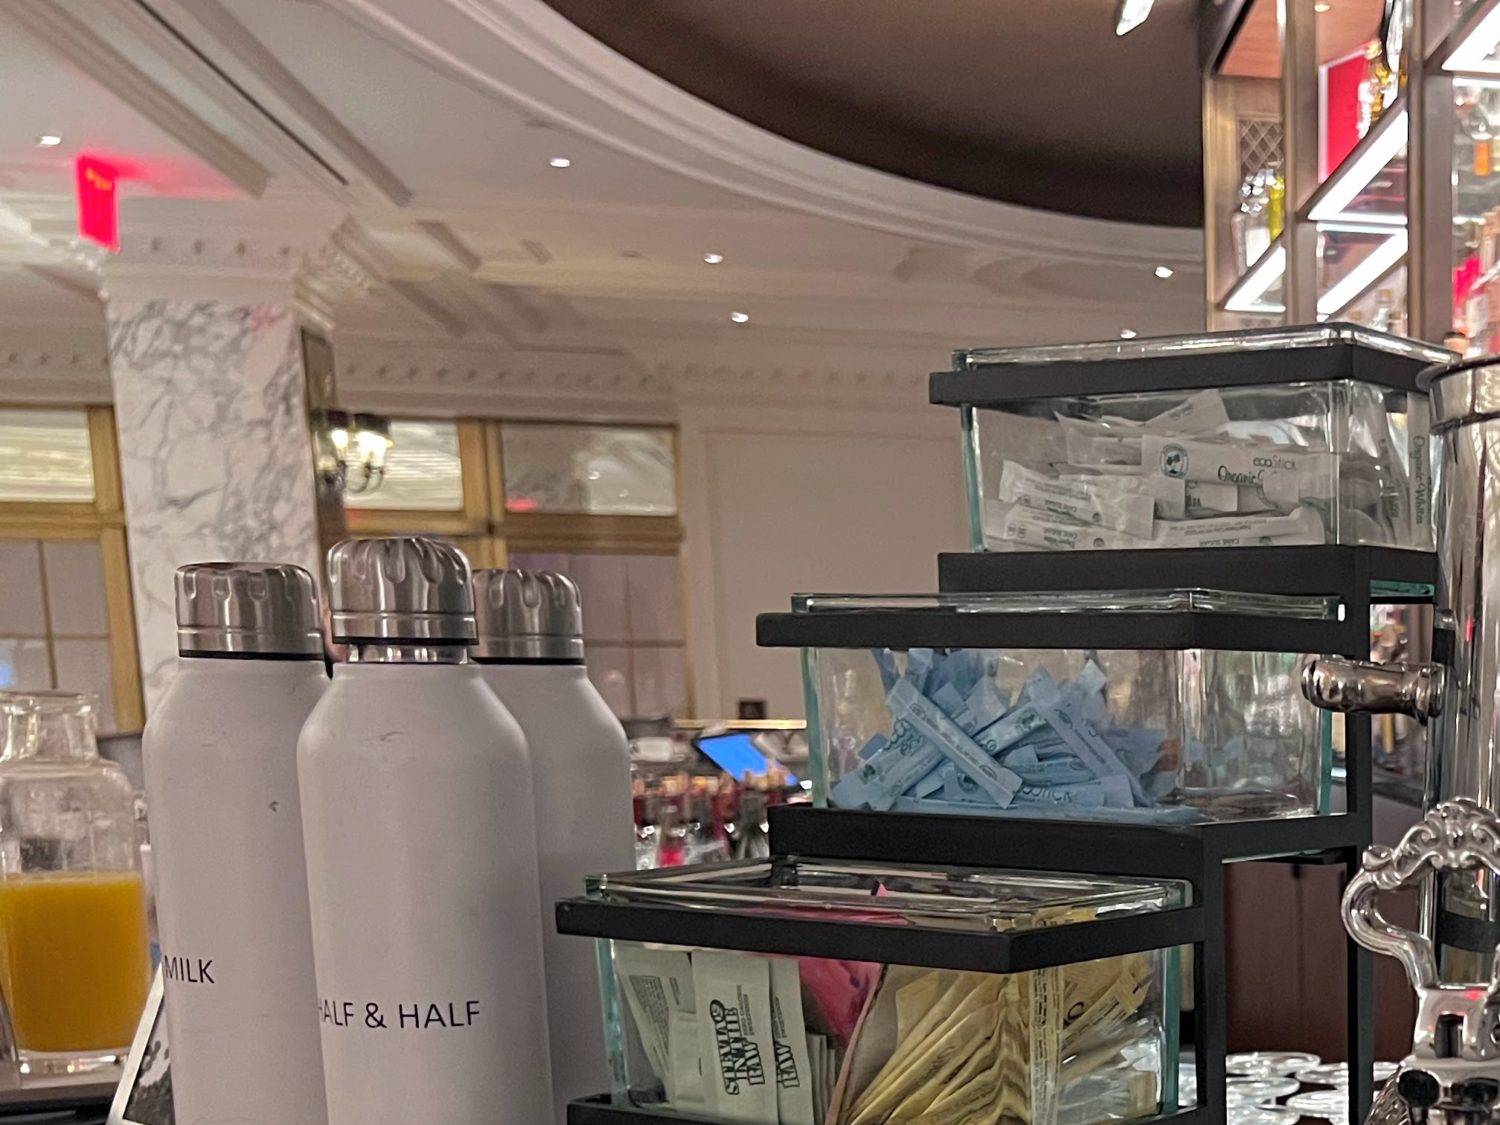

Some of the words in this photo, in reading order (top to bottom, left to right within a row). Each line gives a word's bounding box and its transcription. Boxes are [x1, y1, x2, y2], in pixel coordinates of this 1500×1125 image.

[164, 954, 215, 985] MILK
[365, 1002, 387, 1028] &
[399, 1000, 480, 1029] HALF
[724, 1007, 747, 1053] THE
[714, 1016, 740, 1095] STEVIA
[732, 1056, 749, 1080] IN
[744, 1041, 766, 1086] RAW
[775, 1041, 800, 1089] RAW
